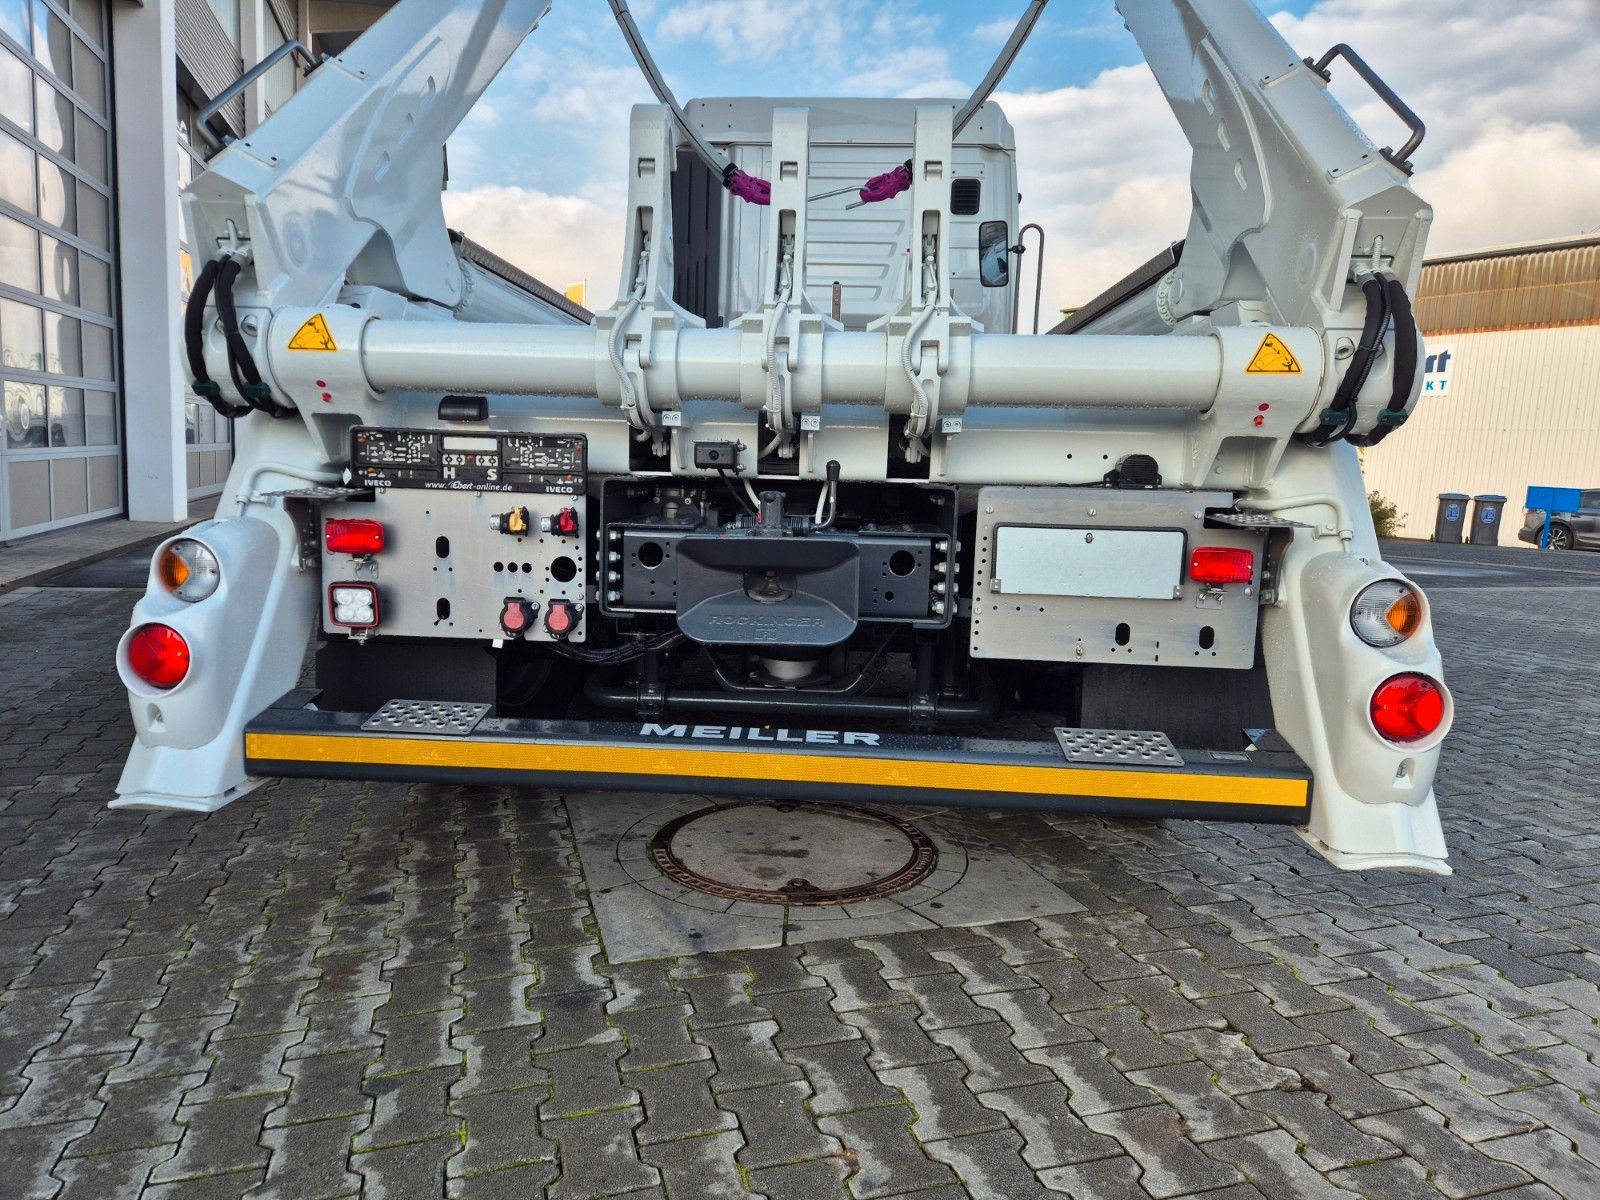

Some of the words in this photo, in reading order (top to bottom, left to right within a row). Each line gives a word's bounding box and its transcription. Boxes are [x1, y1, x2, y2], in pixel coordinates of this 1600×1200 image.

[364, 479, 392, 487] IVECO
[545, 485, 574, 494] IVECO
[708, 615, 825, 628] ROCKINGER
[639, 723, 881, 746] MEILLER
